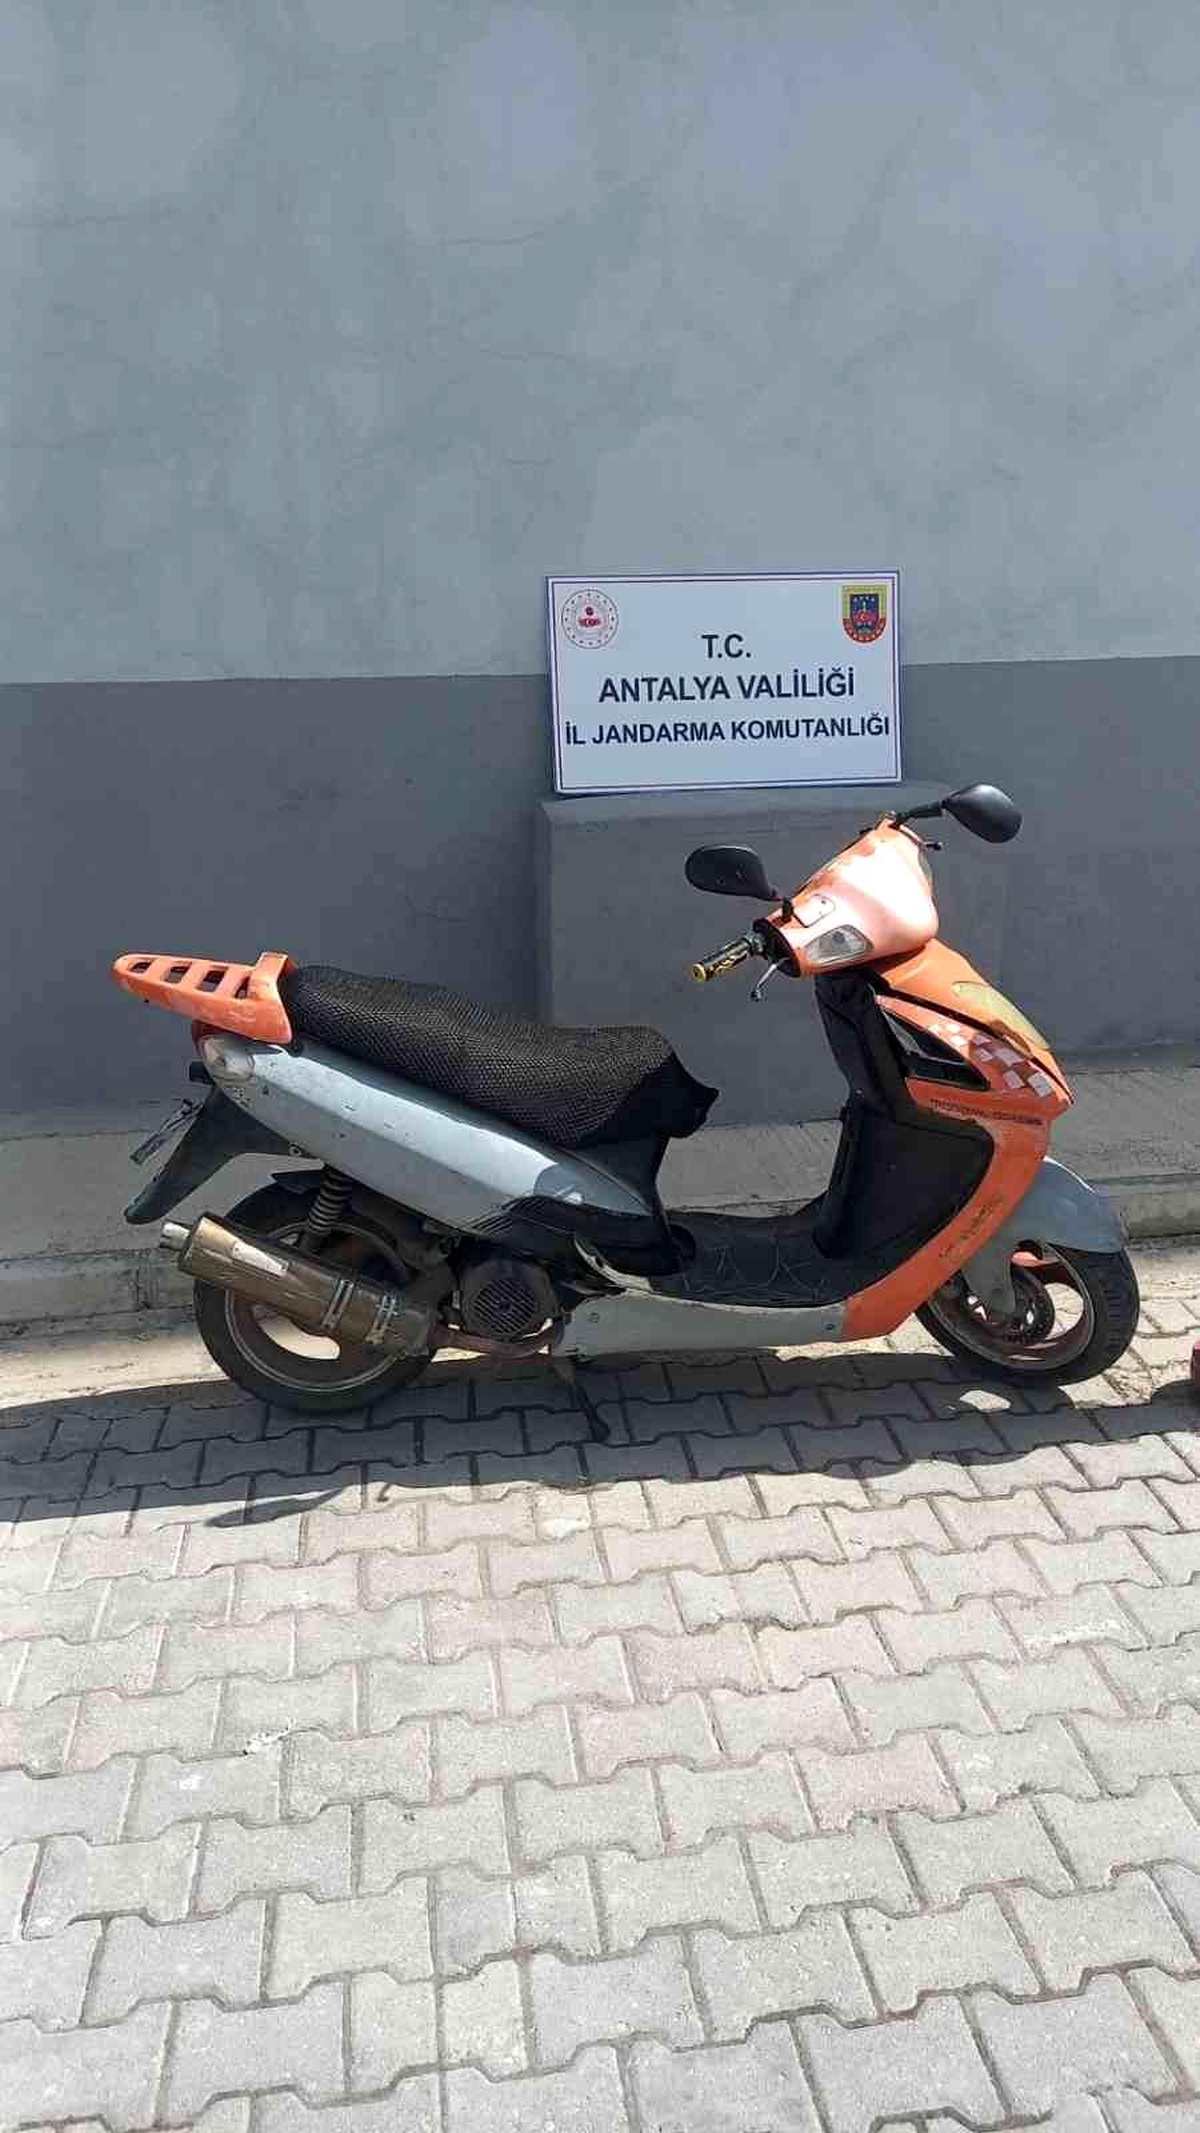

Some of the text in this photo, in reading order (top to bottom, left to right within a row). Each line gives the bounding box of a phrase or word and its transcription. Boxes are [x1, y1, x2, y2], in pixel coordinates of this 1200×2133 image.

[701, 633, 752, 659] T.C.
[599, 667, 855, 703] ANTALYA VALİLİĞİ
[566, 712, 890, 745] İL JANDARMA KOMUTANLIĞI
